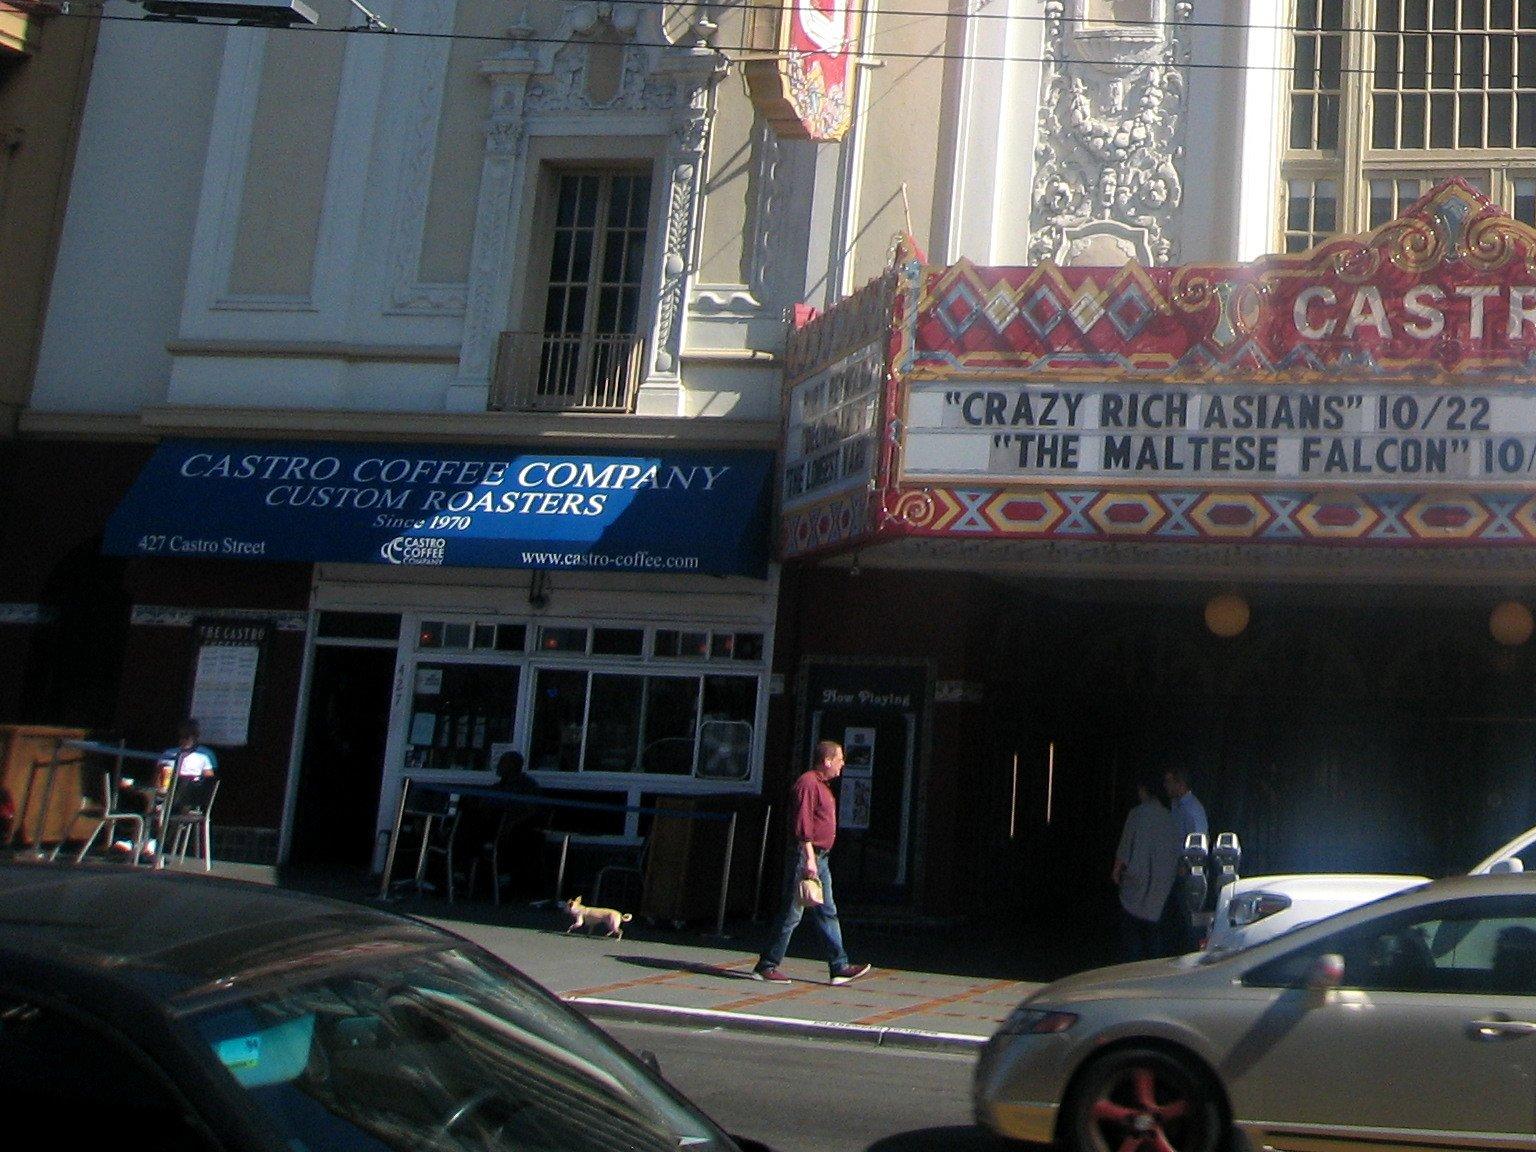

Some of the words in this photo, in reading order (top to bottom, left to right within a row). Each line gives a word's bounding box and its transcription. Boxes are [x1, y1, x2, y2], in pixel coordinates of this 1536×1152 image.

[945, 391, 1083, 428] "CRAZY
[1100, 393, 1188, 428] RICH
[1203, 394, 1363, 431] ASIANS"
[1378, 395, 1490, 431] 10/22
[994, 435, 1078, 470] "THE
[1102, 437, 1278, 473] MALTESE
[1302, 438, 1469, 474] FALCON"
[180, 452, 341, 481] CASTRO
[353, 458, 509, 486] COFFEE
[518, 462, 730, 491] COMPANY
[265, 485, 412, 511] CUSTOM
[421, 490, 608, 517] ROASTERS
[373, 513, 426, 530] Since
[428, 514, 471, 531] 1970
[138, 535, 166, 551] 427
[169, 535, 219, 553] Castro
[222, 537, 266, 554] Street
[404, 537, 446, 548] CASTRO
[403, 548, 445, 558] COFFEE
[521, 550, 699, 569] www.castro-coffee.com
